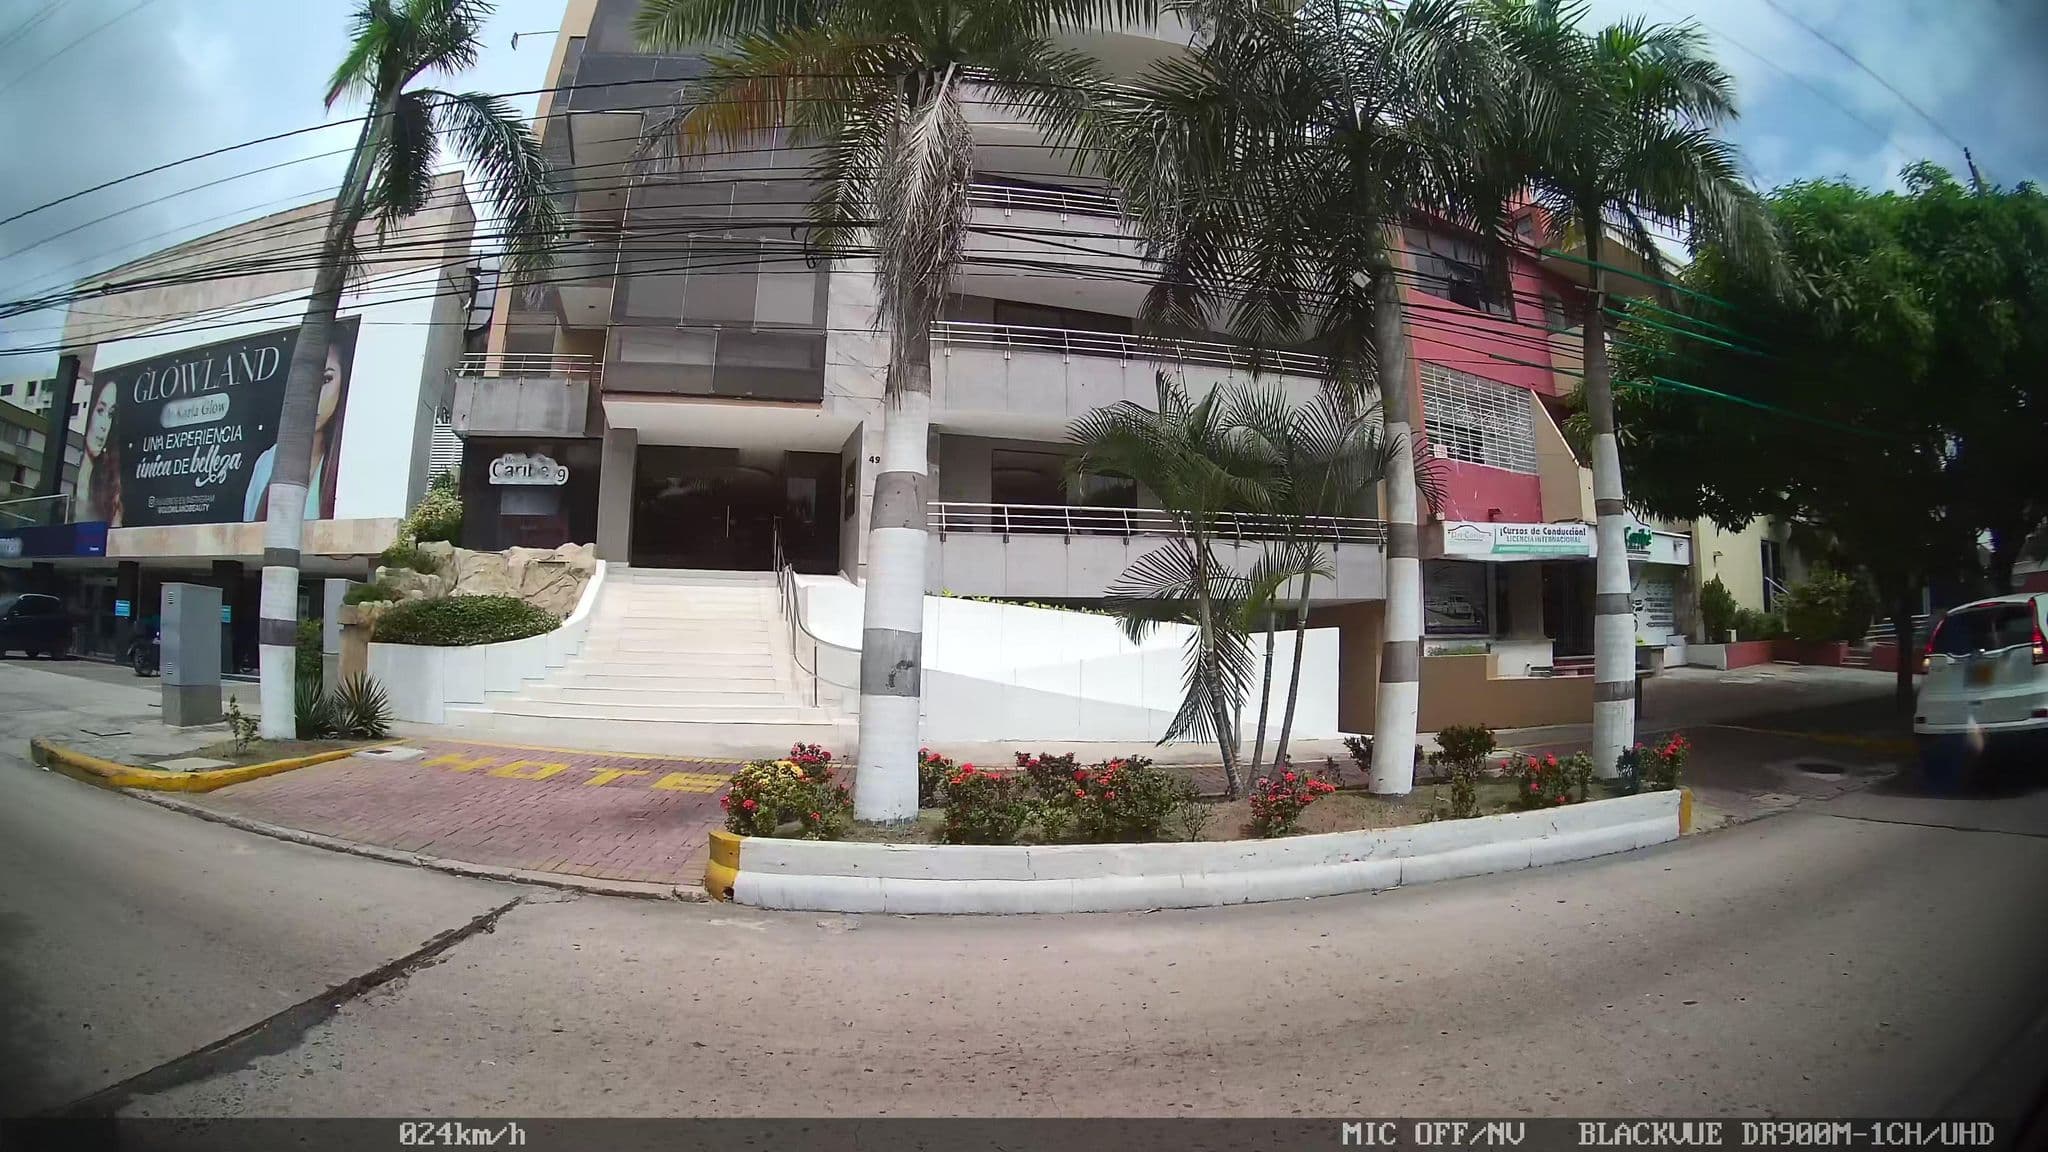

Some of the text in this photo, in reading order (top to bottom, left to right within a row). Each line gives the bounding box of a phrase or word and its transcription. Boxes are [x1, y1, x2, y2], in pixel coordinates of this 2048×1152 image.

[134, 346, 279, 403] GLOWLAND
[143, 425, 242, 452] UNA EXPERIENCIA
[173, 458, 189, 474] DE
[190, 445, 242, 487] belleza
[869, 455, 881, 464] 49
[1506, 536, 1582, 544] LICENCIA INTERNACIONAL
[1531, 527, 1541, 536] de
